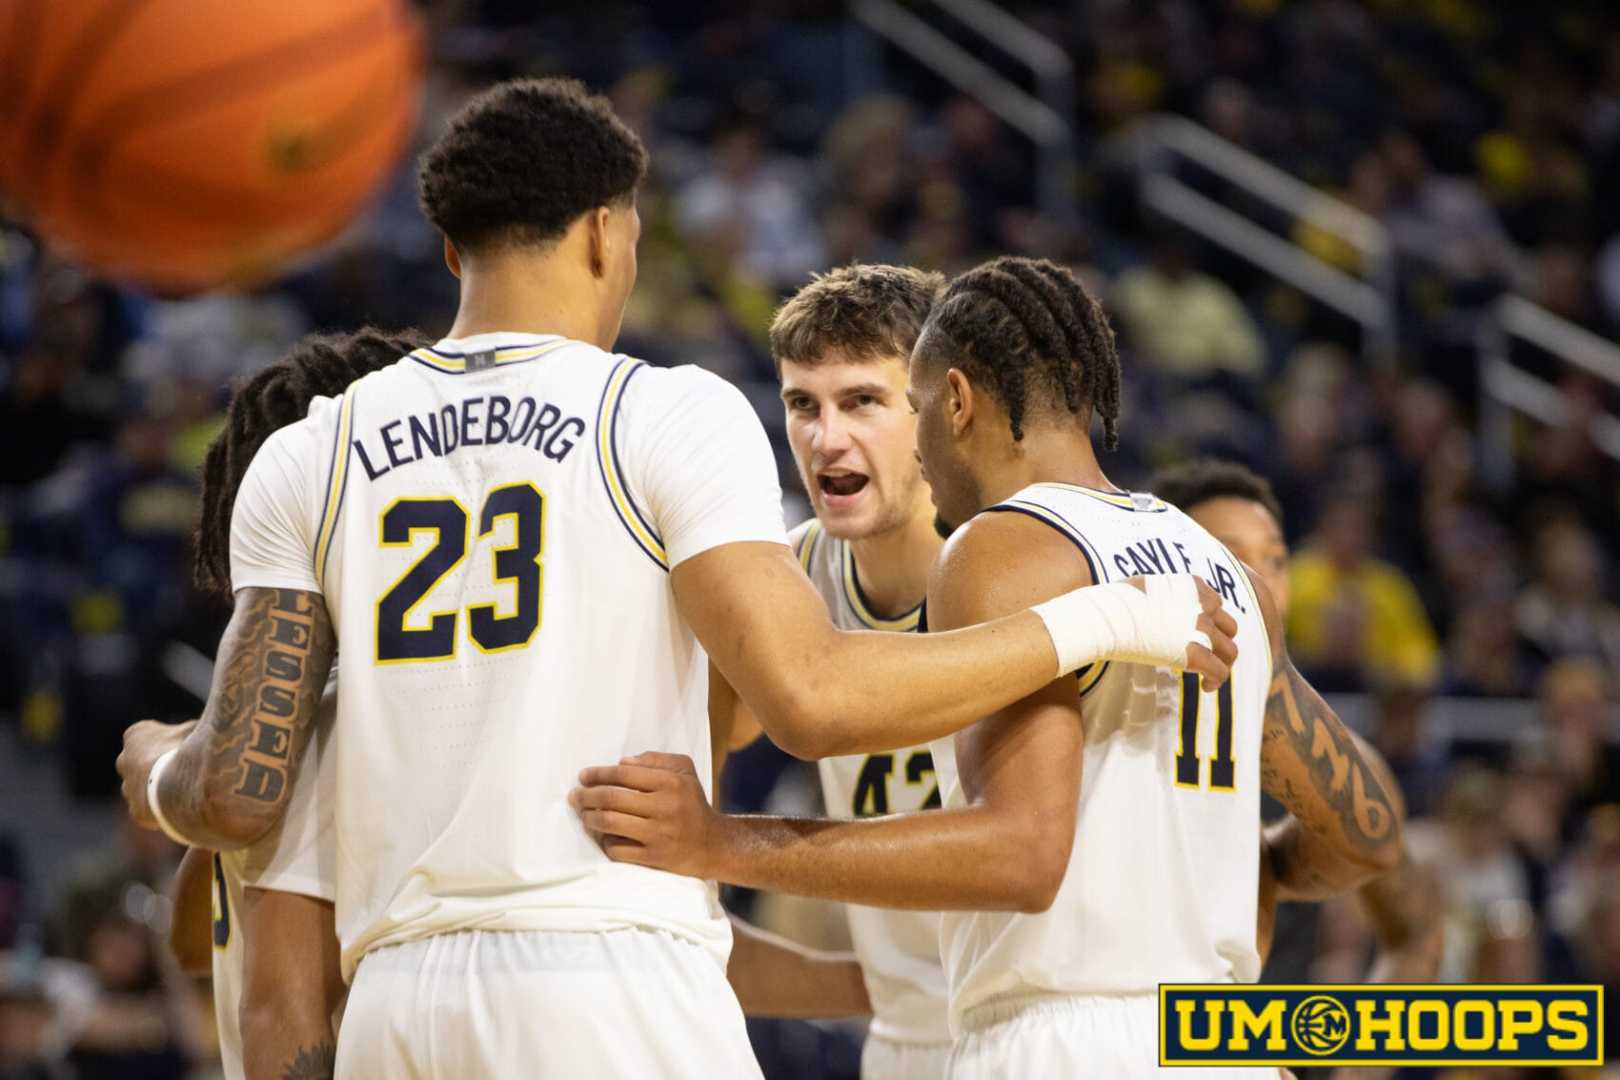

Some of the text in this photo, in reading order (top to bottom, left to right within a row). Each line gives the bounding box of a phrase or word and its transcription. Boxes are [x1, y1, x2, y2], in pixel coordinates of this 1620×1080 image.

[352, 395, 586, 481] LENDEBORG
[374, 480, 546, 664] 23
[1206, 556, 1246, 614] JR.
